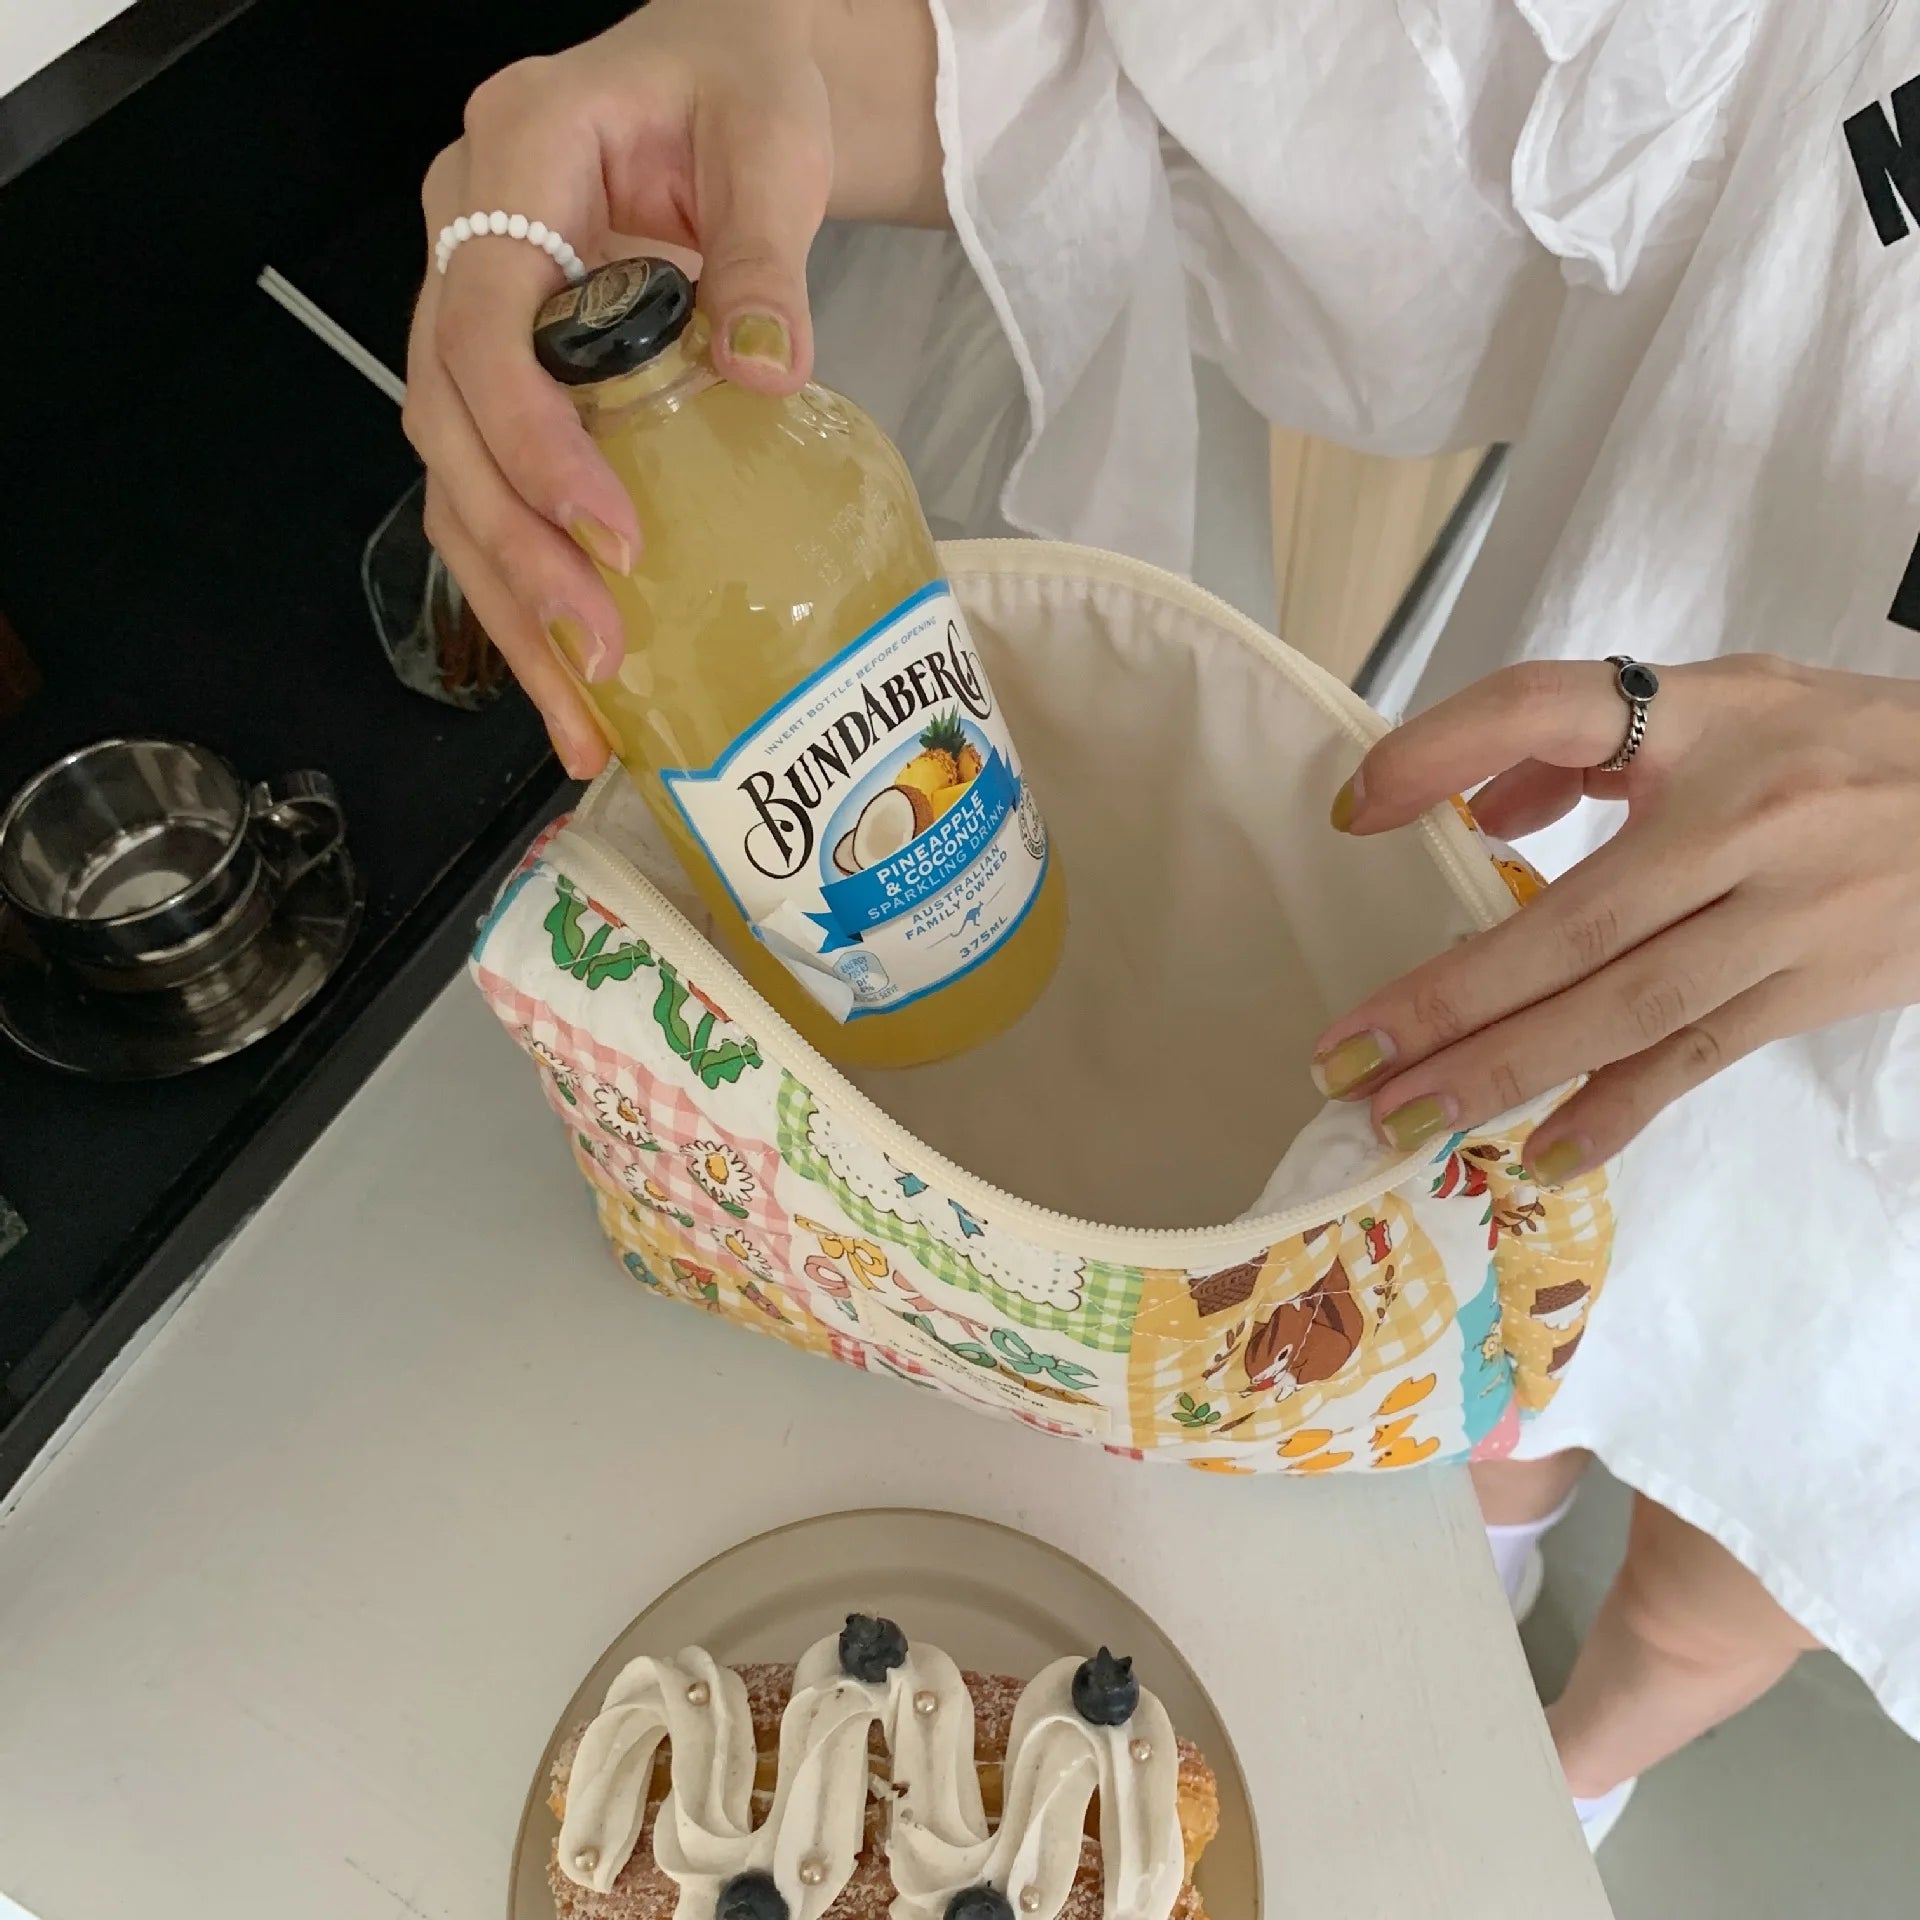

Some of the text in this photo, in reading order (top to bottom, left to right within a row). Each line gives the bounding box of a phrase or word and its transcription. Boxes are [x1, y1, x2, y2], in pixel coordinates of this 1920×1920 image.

[764, 616, 938, 756] INVERT BOTTLE BEFORE OPENING
[737, 619, 992, 880] BUNDABERG
[867, 850, 967, 920] SPARKLING
[969, 800, 1005, 850] DRINK
[876, 789, 983, 885] PINEAPPLE
[885, 882, 903, 897] &
[904, 803, 986, 885] COCONUT
[912, 844, 1000, 925] AUSTRALIAN
[904, 850, 1008, 941] FAMILY OWNED
[841, 957, 867, 973] ENERGY
